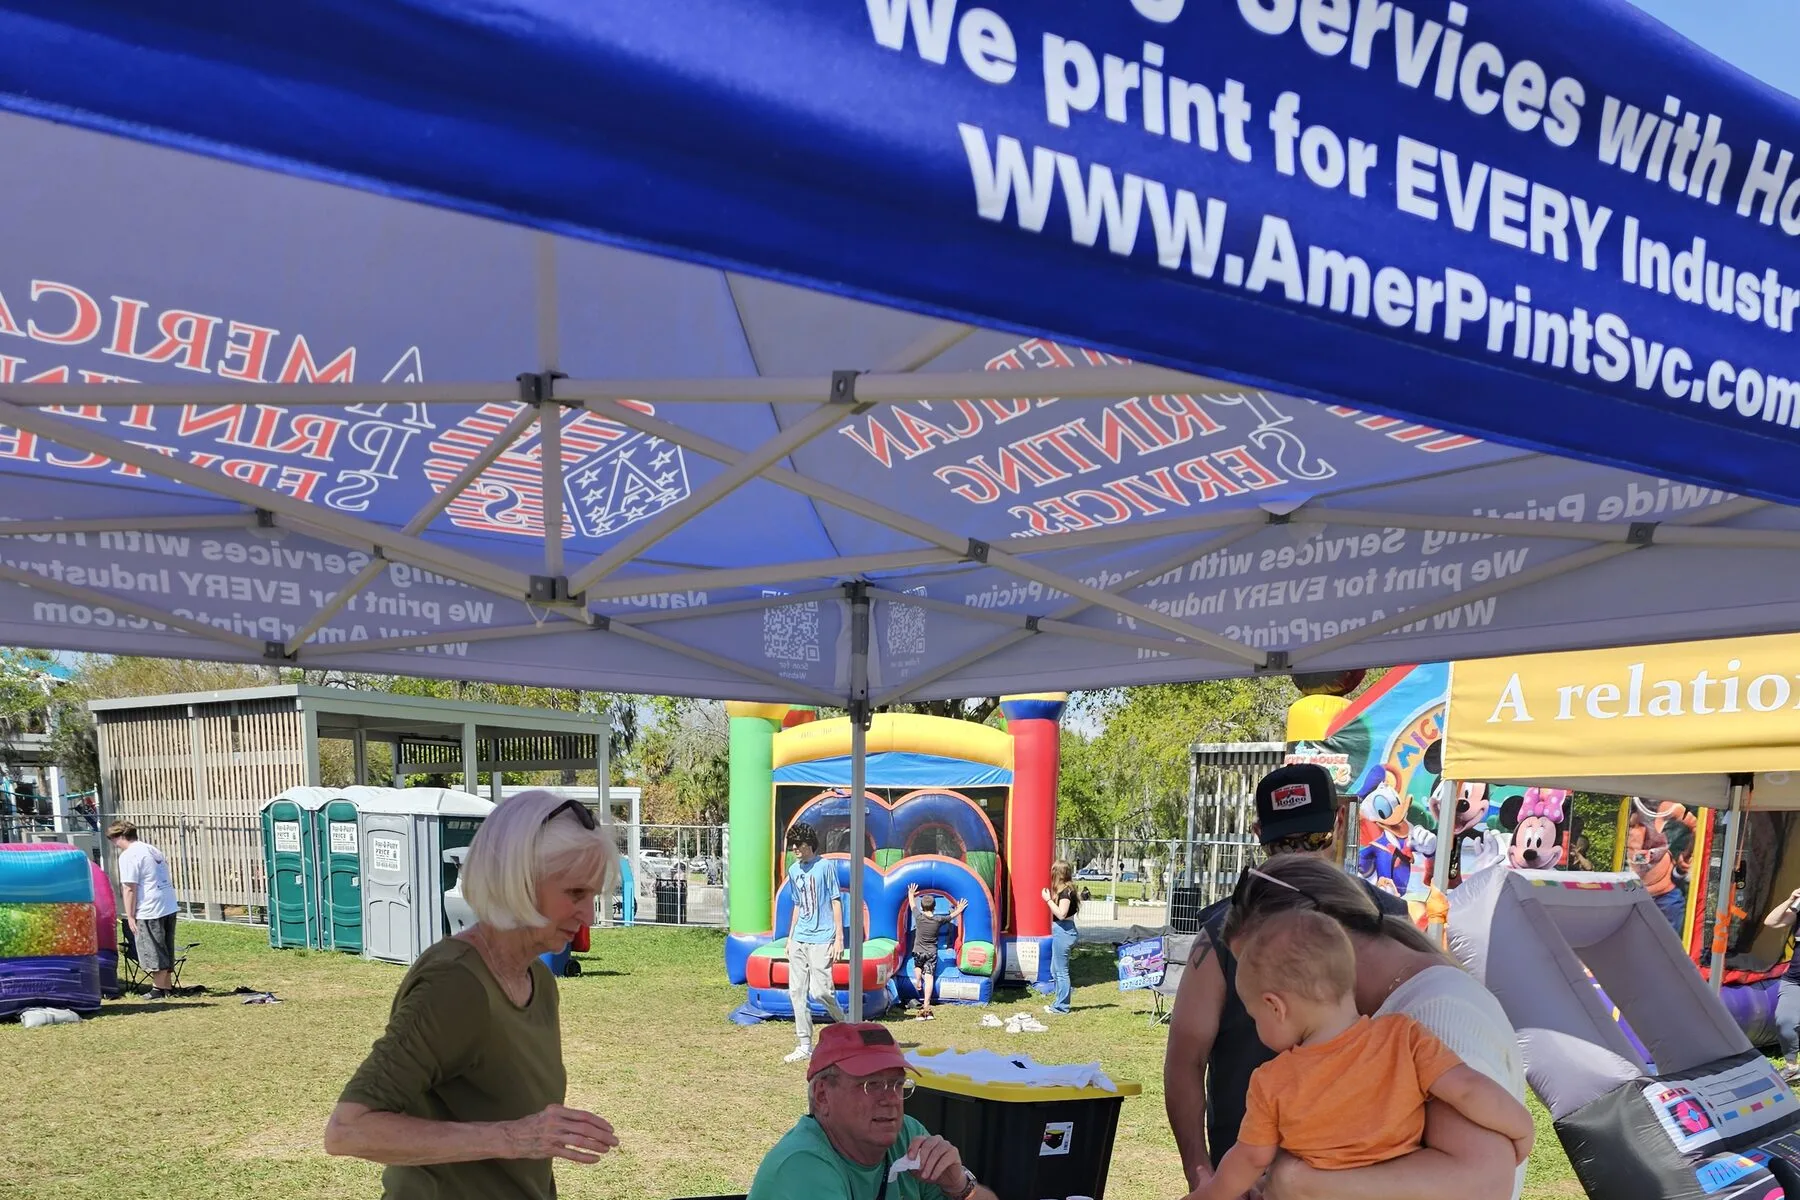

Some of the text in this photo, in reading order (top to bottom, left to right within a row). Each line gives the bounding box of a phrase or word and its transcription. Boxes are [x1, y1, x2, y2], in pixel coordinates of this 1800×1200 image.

[864, 0, 1800, 333] We print for EVERY Industr
[1598, 94, 1733, 205] with
[1486, 658, 1800, 724] A relatio
